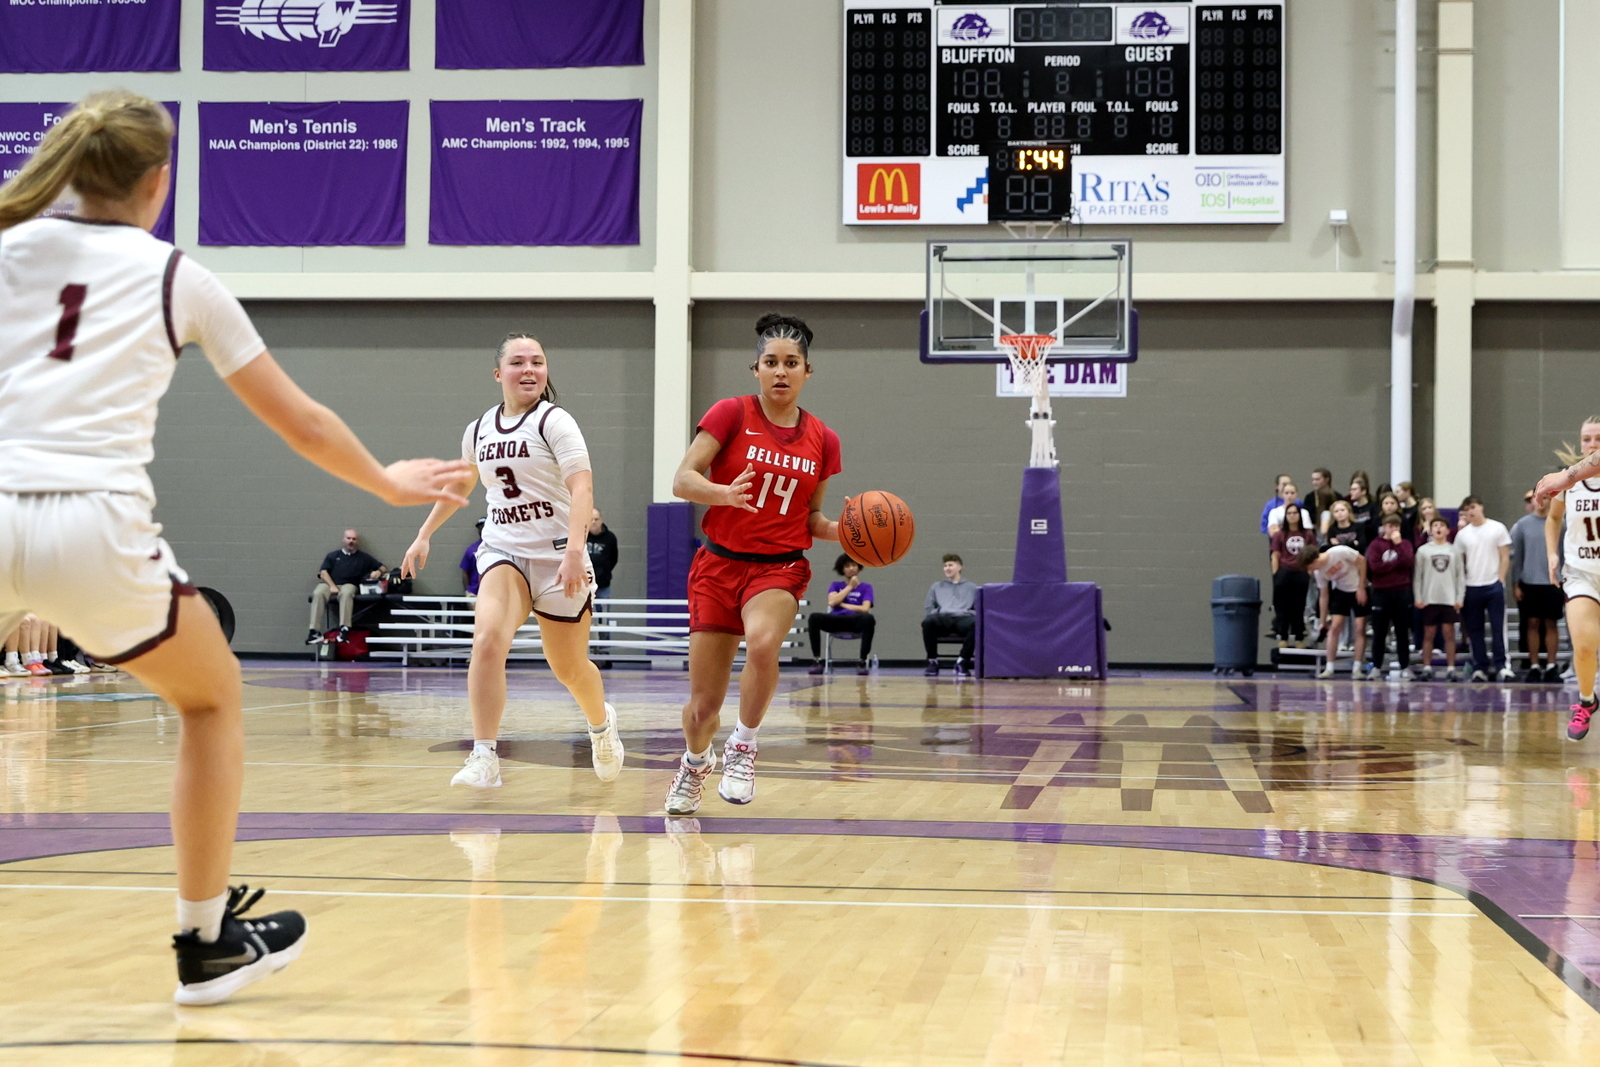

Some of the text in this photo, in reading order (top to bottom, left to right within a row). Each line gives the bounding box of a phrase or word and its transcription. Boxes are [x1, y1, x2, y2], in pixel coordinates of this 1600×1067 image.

[853, 13, 874, 24] PLYR
[882, 13, 897, 24] FLS
[907, 13, 923, 24] PTS
[1202, 10, 1223, 21] PLYR
[1232, 9, 1247, 20] FLS
[1258, 9, 1273, 20] PTS
[942, 48, 1015, 63] BLUFFTON
[1125, 46, 1173, 62] GUEST
[1044, 55, 1080, 67] PERIOD
[948, 102, 980, 114] FOULS
[990, 102, 1018, 113] T.O.L.
[1028, 101, 1097, 113] PLAYER FOUL
[1106, 101, 1134, 112] T.O.L.
[1146, 101, 1178, 112] FOULS
[250, 119, 357, 134] Men's Tennis
[486, 118, 586, 132] Men's Track
[209, 139, 398, 152] NAIA Champions (District 22): 1986
[442, 138, 630, 150] AMC Champions: 1992, 1994, 1995
[948, 144, 980, 156] SCORE
[1146, 143, 1178, 154] SCORE
[1019, 150, 1064, 170] 1:44
[1232, 196, 1274, 206] Hospital
[860, 204, 918, 214] Lewis Family
[1089, 205, 1169, 215] PARTNERS
[47, 284, 88, 361] 1
[1064, 363, 1117, 384] DAM
[479, 441, 530, 462] GENOA
[746, 445, 816, 476] BELLEVUE
[496, 466, 522, 499] 3
[756, 472, 798, 516] 14
[1576, 500, 1600, 512] GEN
[492, 501, 554, 525] COMETS
[1578, 546, 1600, 558] COM
